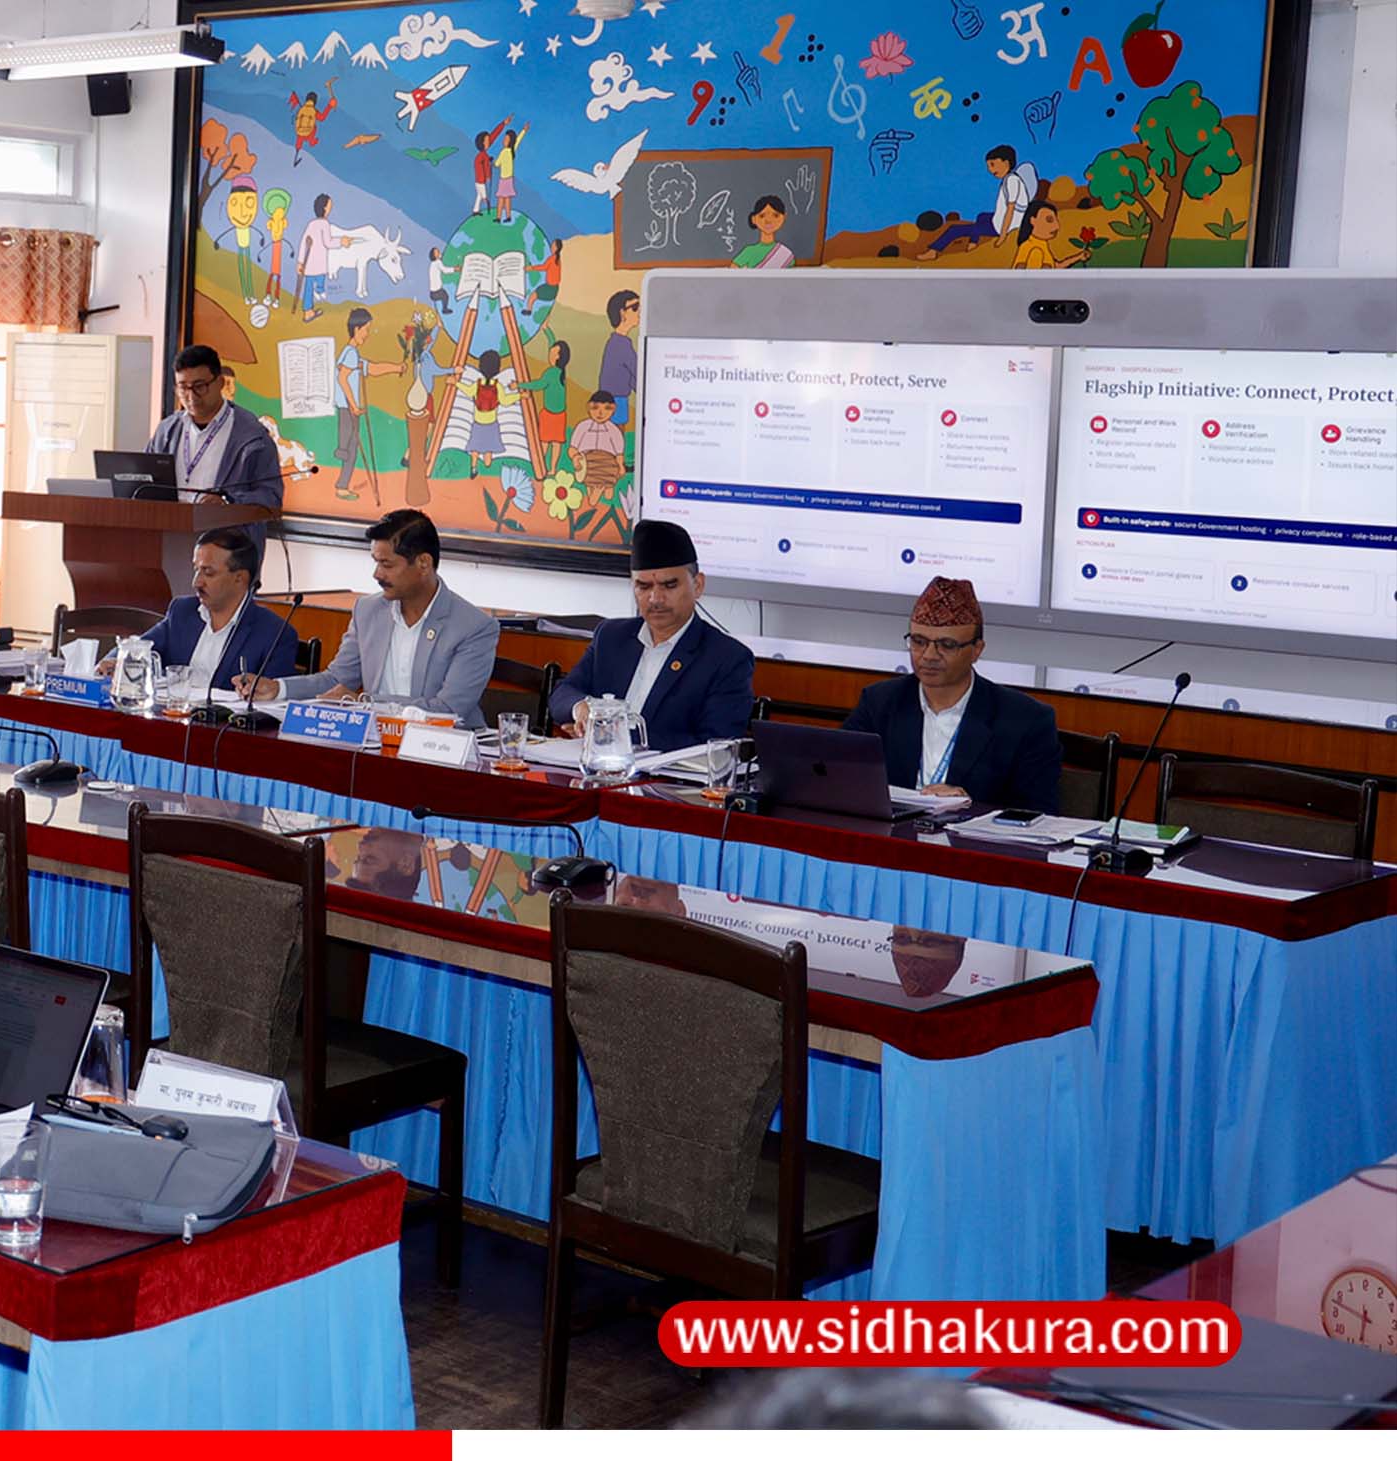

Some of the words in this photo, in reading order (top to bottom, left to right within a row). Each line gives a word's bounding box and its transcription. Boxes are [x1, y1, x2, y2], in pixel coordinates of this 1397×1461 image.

[760, 14, 795, 64] 1
[997, 3, 1045, 65] अ
[1068, 37, 1112, 91] A
[911, 78, 951, 119] क
[664, 365, 718, 383] Flagship
[721, 368, 783, 383] Initiative:
[787, 370, 846, 387] Connect,
[850, 372, 904, 390] Protect,
[907, 374, 948, 389] Serve
[1084, 378, 1154, 399] Flagship
[1158, 381, 1240, 398] Initiative:
[1244, 383, 1323, 404] Connect,
[1225, 421, 1256, 430] Address
[1346, 425, 1387, 435] Grievance
[1346, 435, 1382, 445] Handling
[47, 677, 87, 693] PREMIUM
